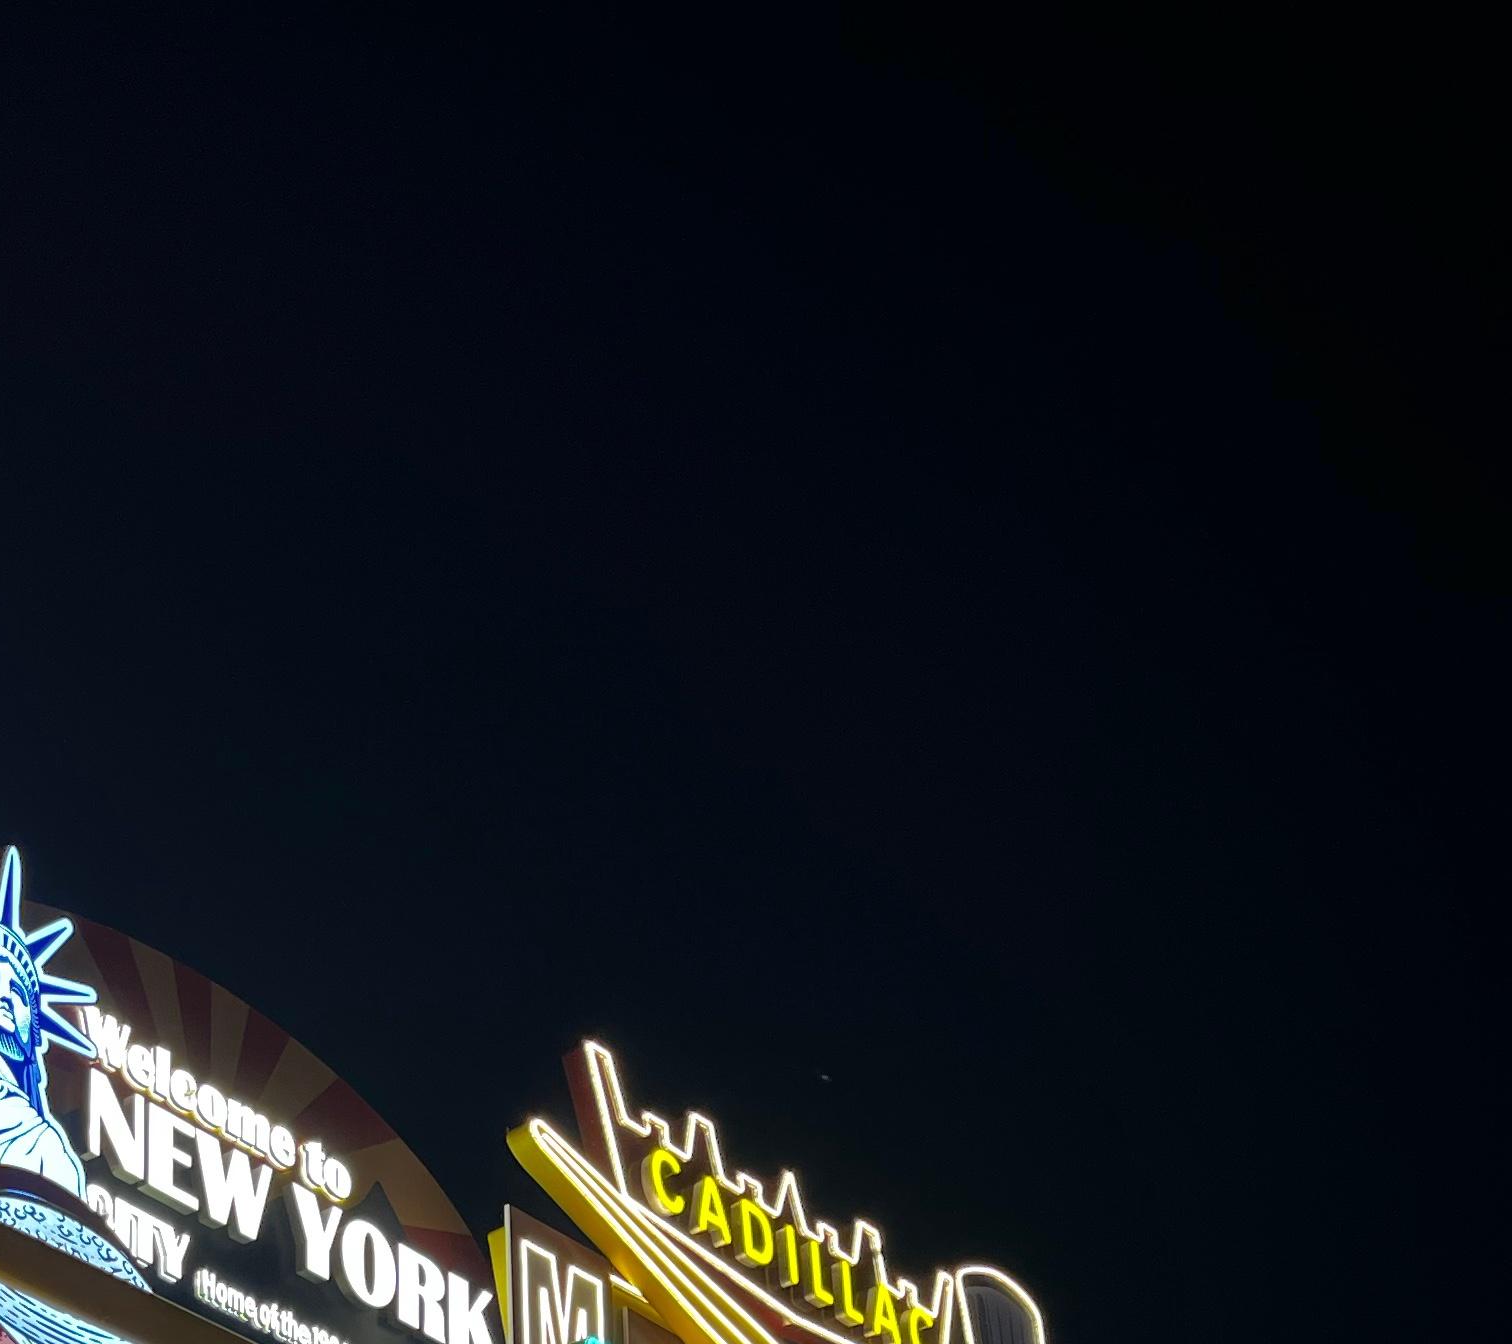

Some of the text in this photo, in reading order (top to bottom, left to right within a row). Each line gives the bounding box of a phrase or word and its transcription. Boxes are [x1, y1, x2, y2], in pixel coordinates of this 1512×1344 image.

[80, 1005, 353, 1205] Welcome to
[84, 1066, 274, 1243] NEW
[194, 1268, 258, 1324] Home
[257, 1302, 279, 1333] of
